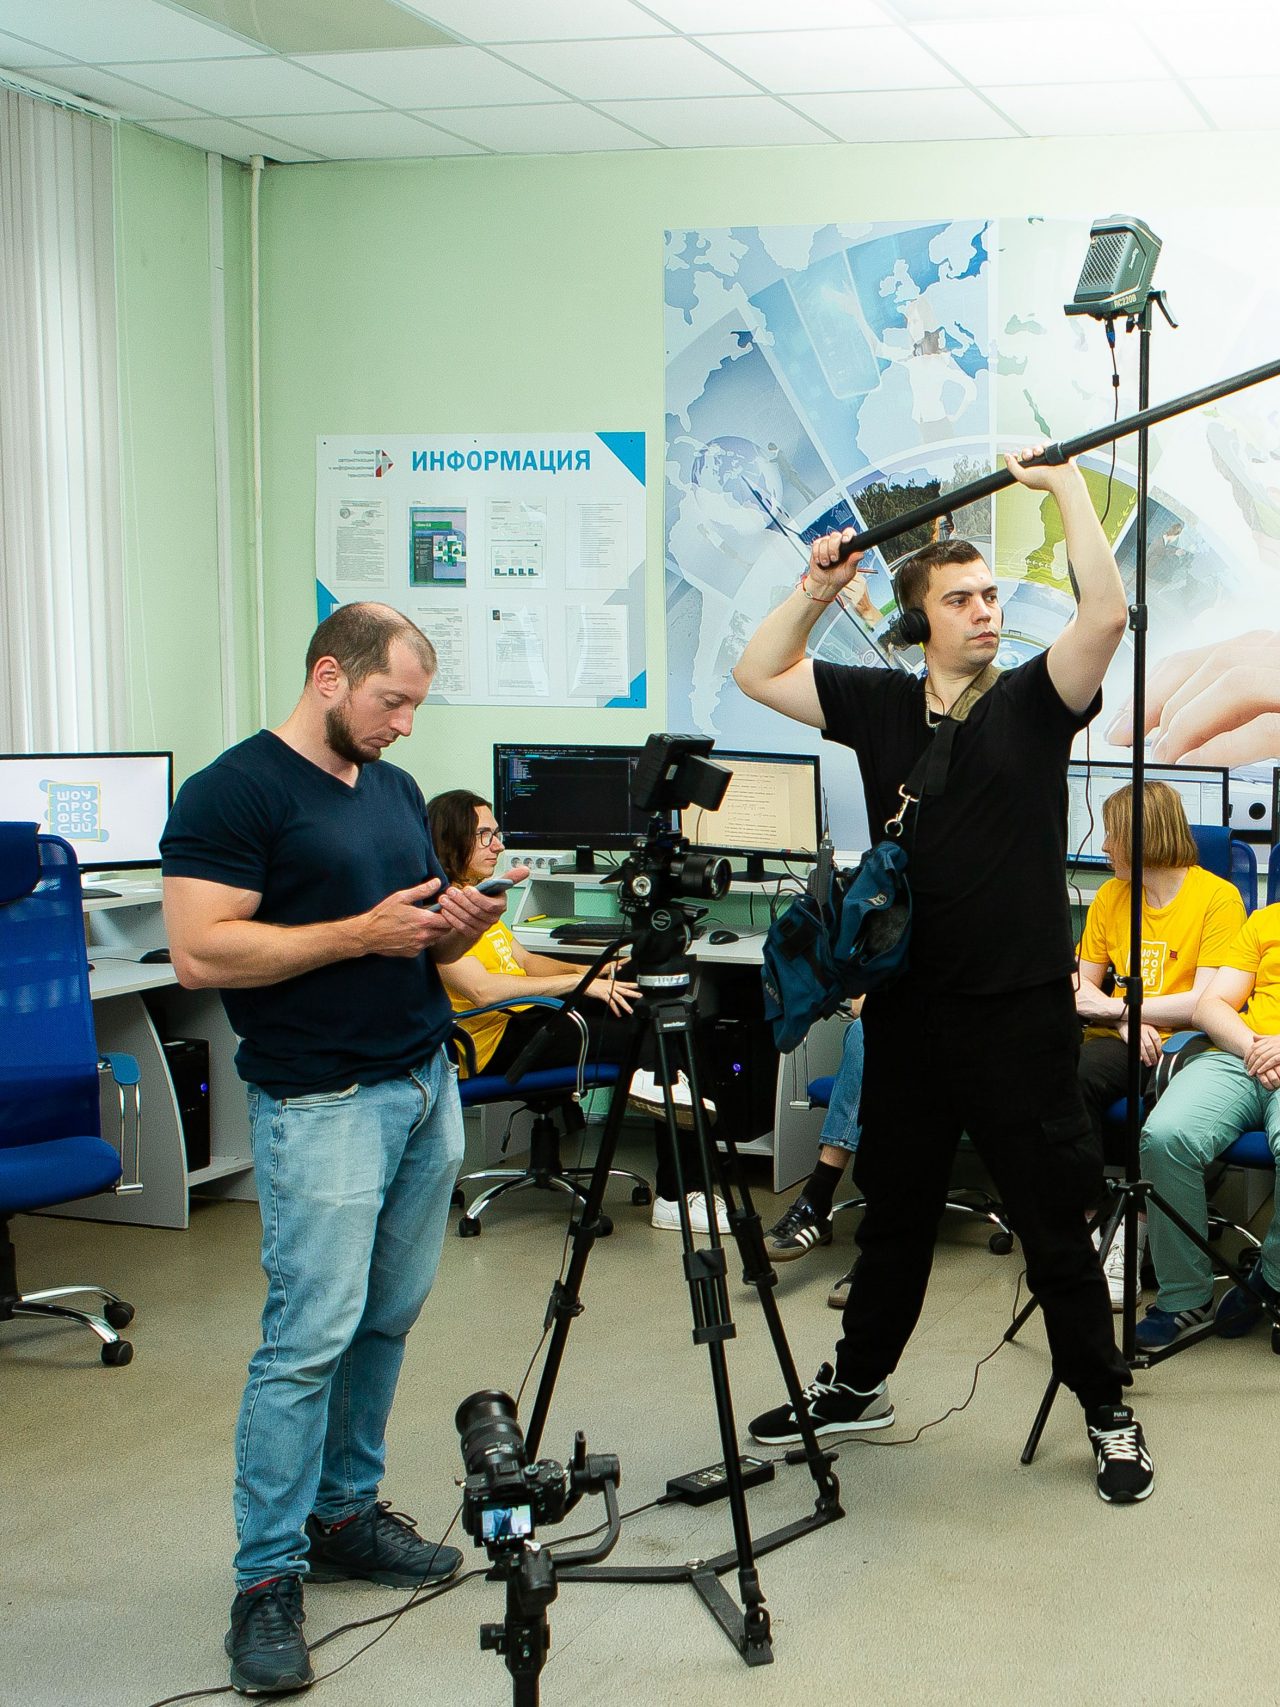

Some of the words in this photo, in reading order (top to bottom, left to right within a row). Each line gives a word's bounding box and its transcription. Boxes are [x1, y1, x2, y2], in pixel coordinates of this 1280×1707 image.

[412, 449, 591, 474] ИНФОРМАЦИЯ
[57, 791, 92, 801] ШОУ
[57, 802, 92, 812] ПРО
